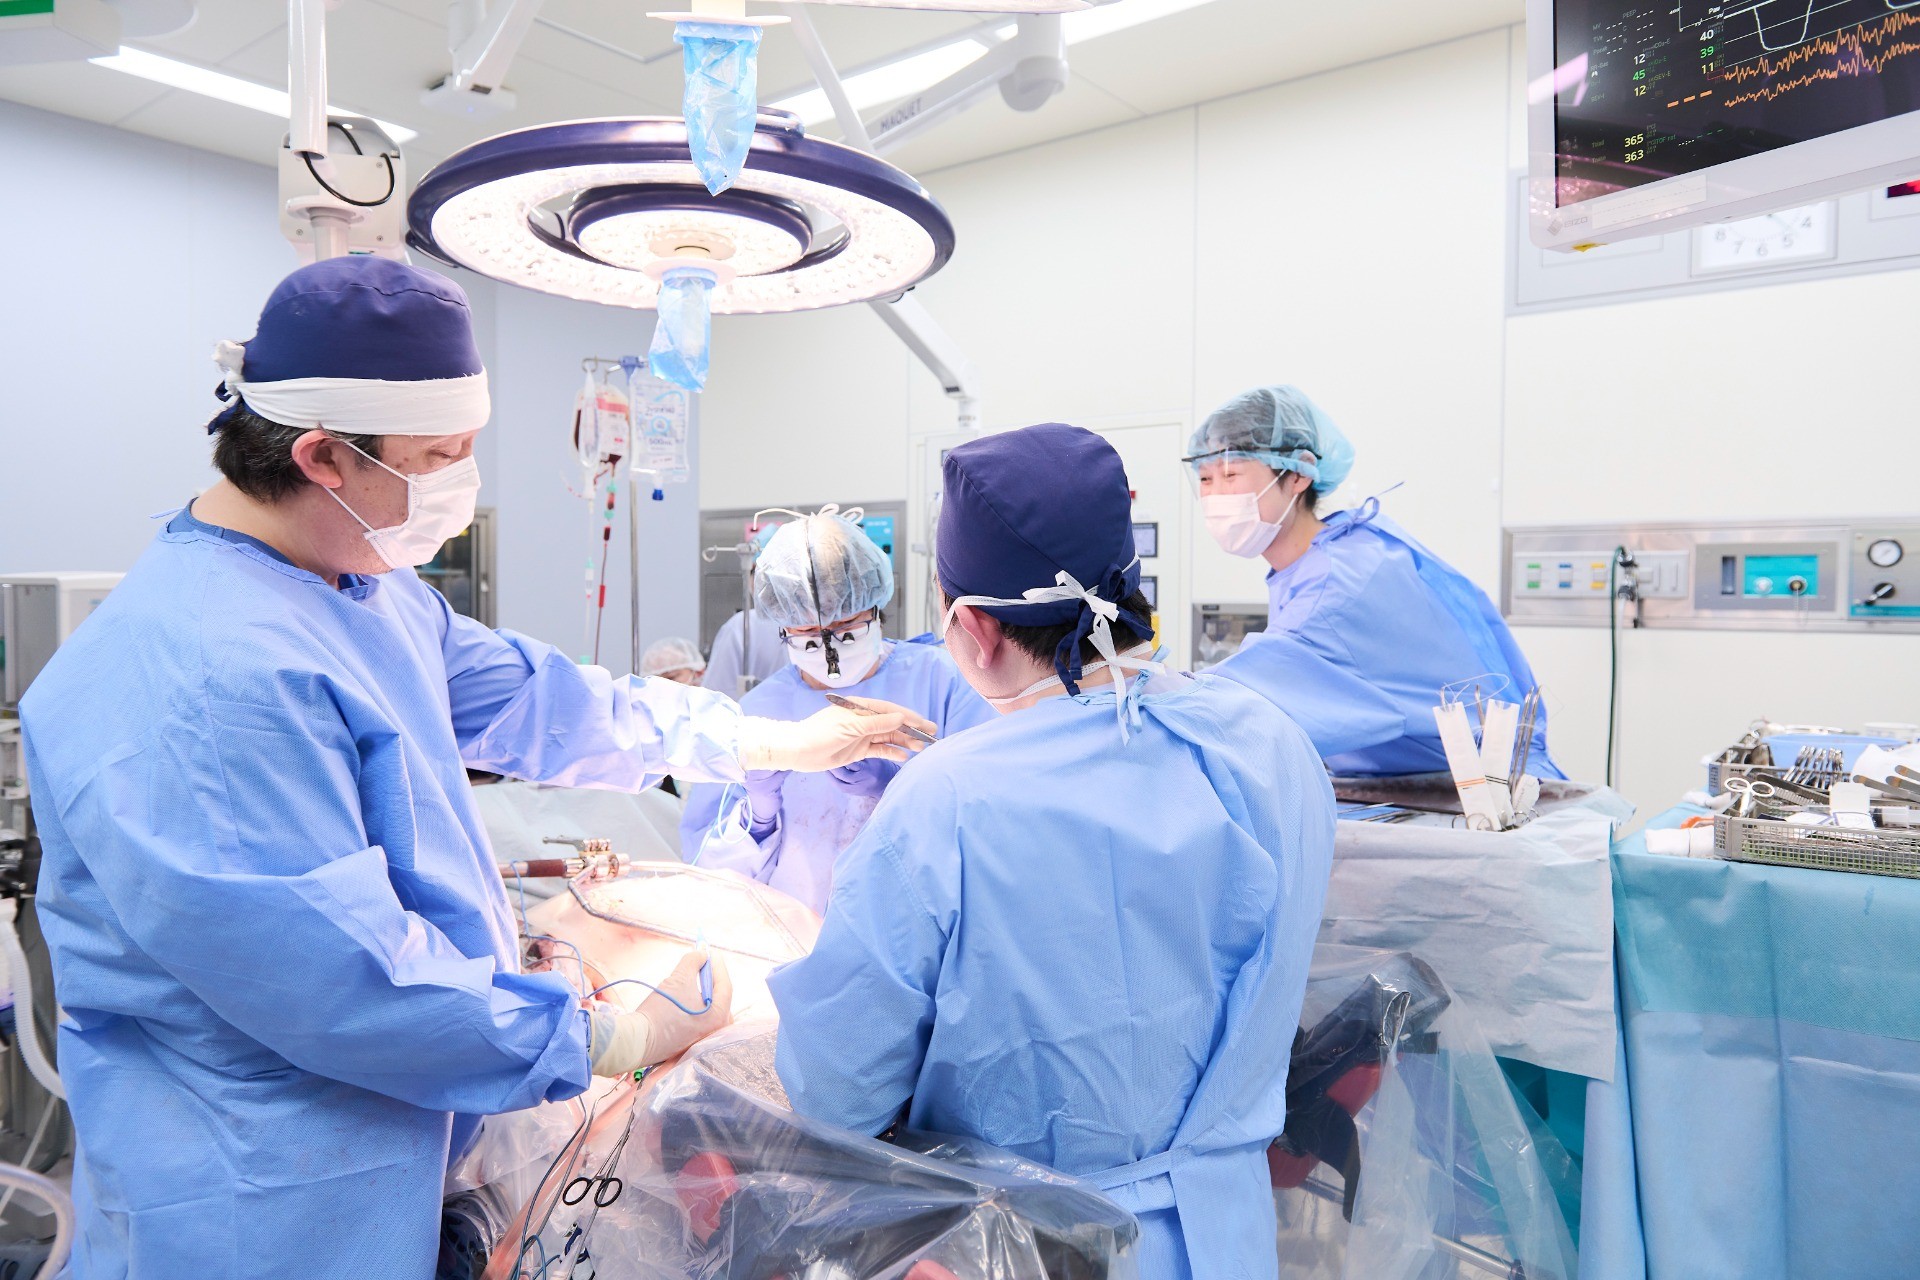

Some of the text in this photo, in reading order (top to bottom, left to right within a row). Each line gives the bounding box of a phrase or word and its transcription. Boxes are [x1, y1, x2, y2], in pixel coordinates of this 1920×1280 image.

[1622, 9, 1637, 19] PEEP
[1699, 29, 1714, 42] 40
[1700, 45, 1714, 59] 39
[1633, 53, 1646, 66] 12
[1632, 69, 1646, 81] 45
[879, 97, 921, 134] MAQUET
[1563, 216, 1588, 228] EIZO
[1800, 216, 1812, 229] 4
[1713, 226, 1727, 242] 8
[1782, 230, 1794, 248] 5
[1733, 239, 1745, 255] 7
[1755, 242, 1769, 258] 6
